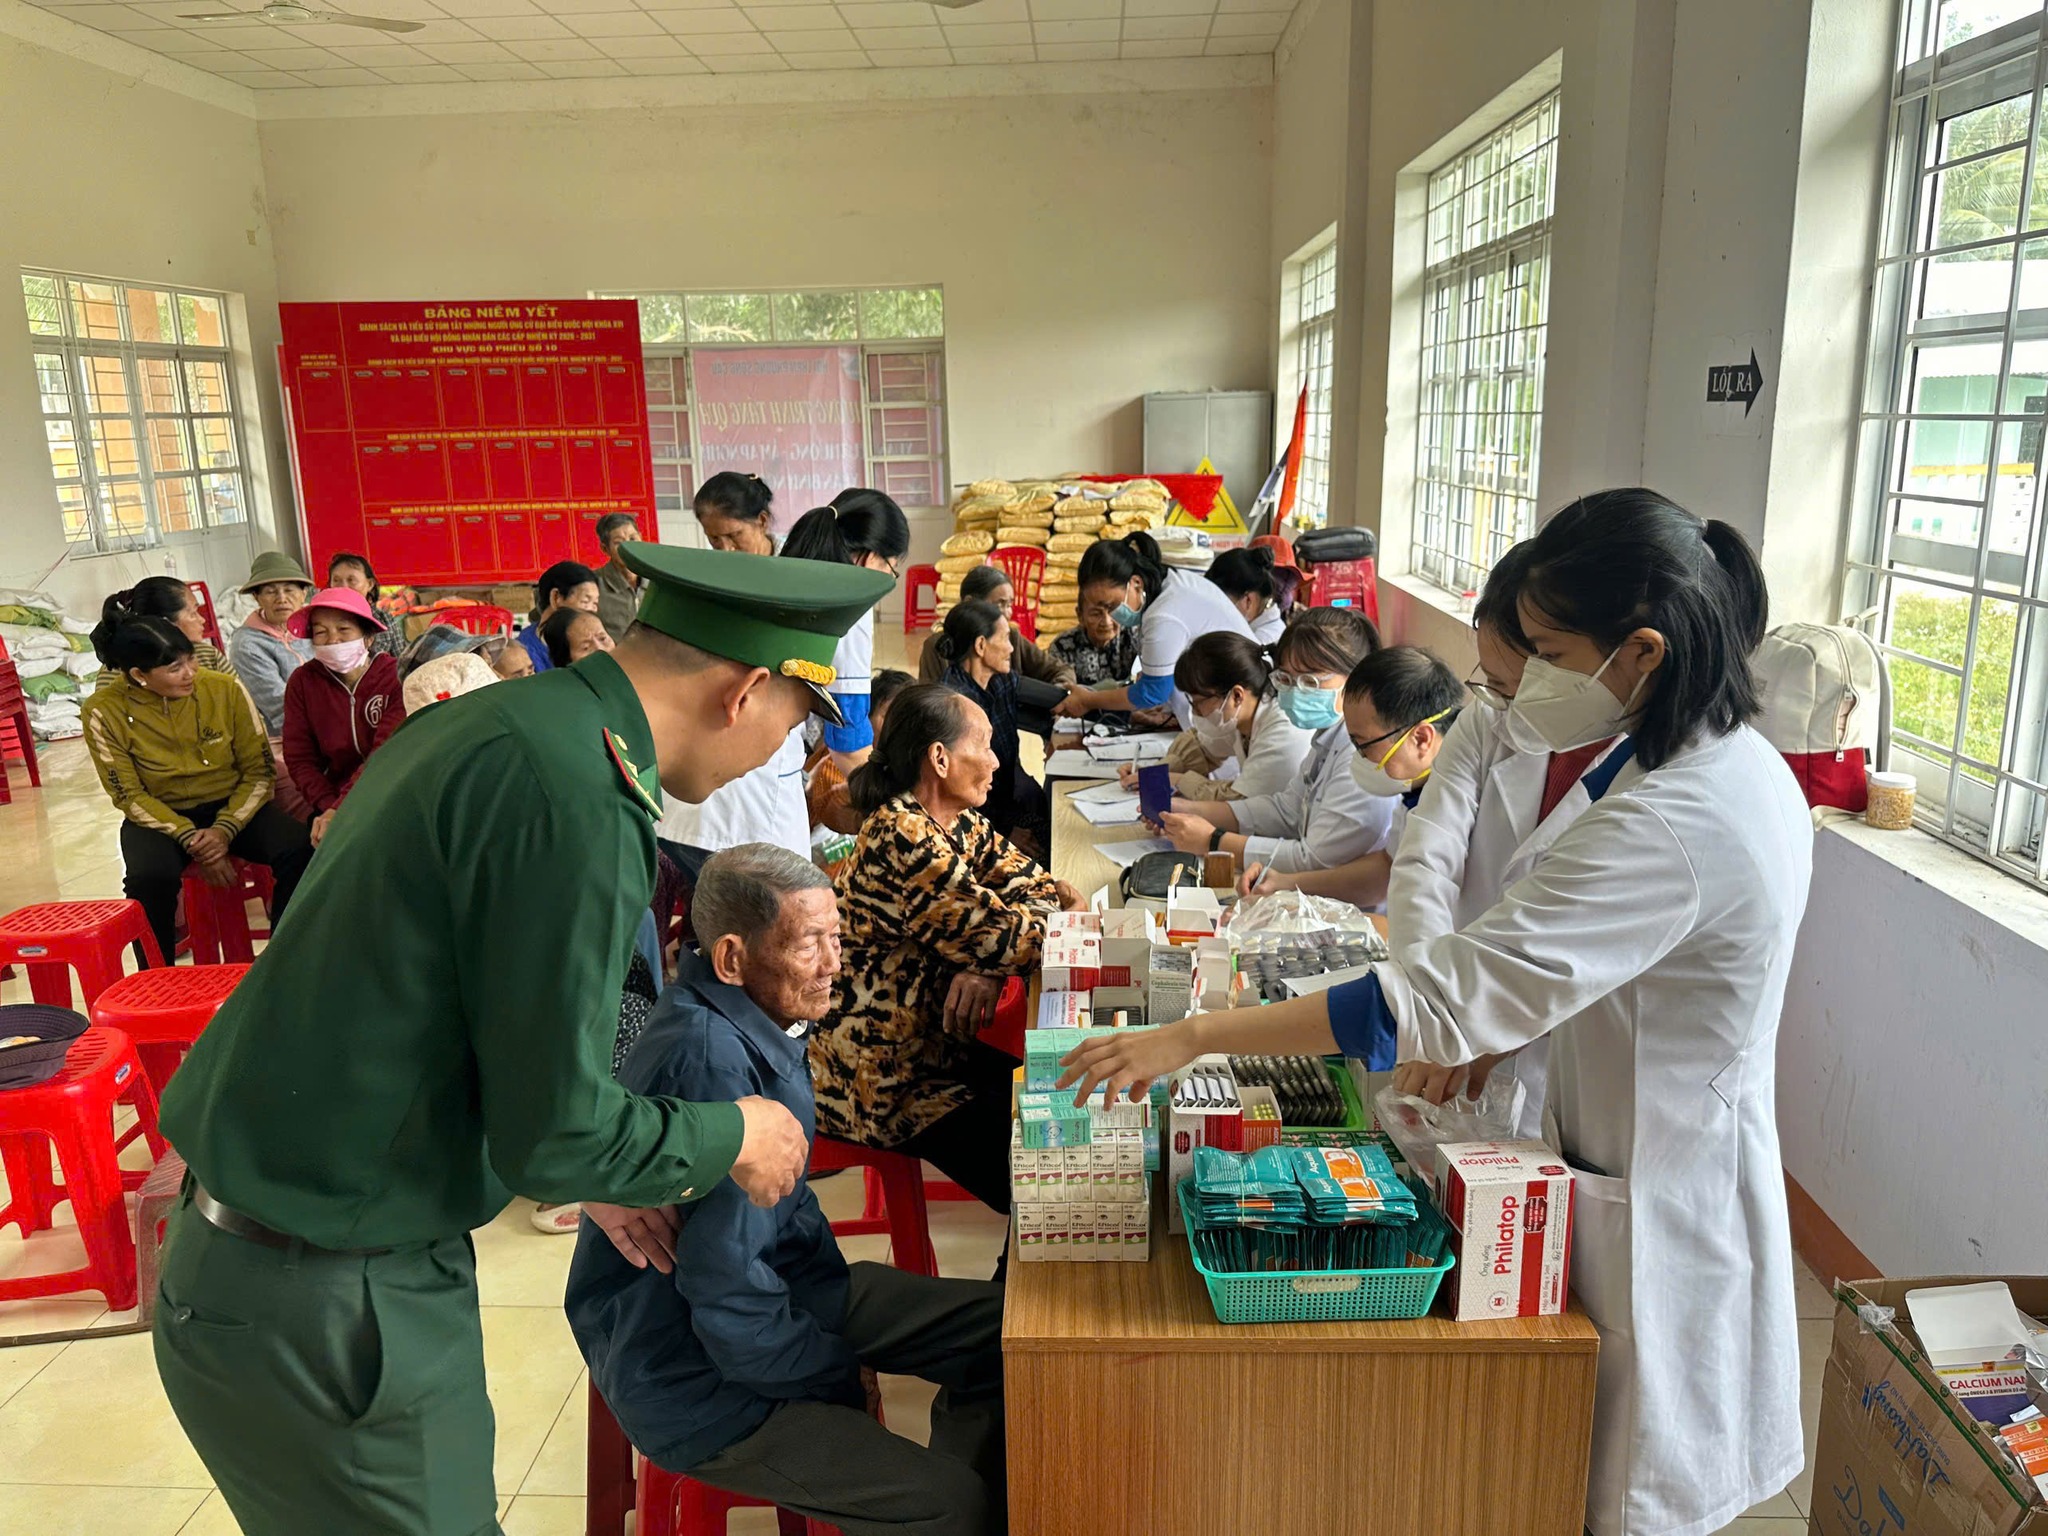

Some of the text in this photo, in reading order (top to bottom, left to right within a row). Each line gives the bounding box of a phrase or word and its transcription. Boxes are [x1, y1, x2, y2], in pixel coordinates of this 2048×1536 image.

[424, 304, 471, 319] BẢNG
[1736, 372, 1752, 392] RA
[1458, 1156, 1520, 1166] Philatop
[1494, 1195, 1519, 1274] Philatop
[1949, 1378, 2002, 1389] CALCIUM
